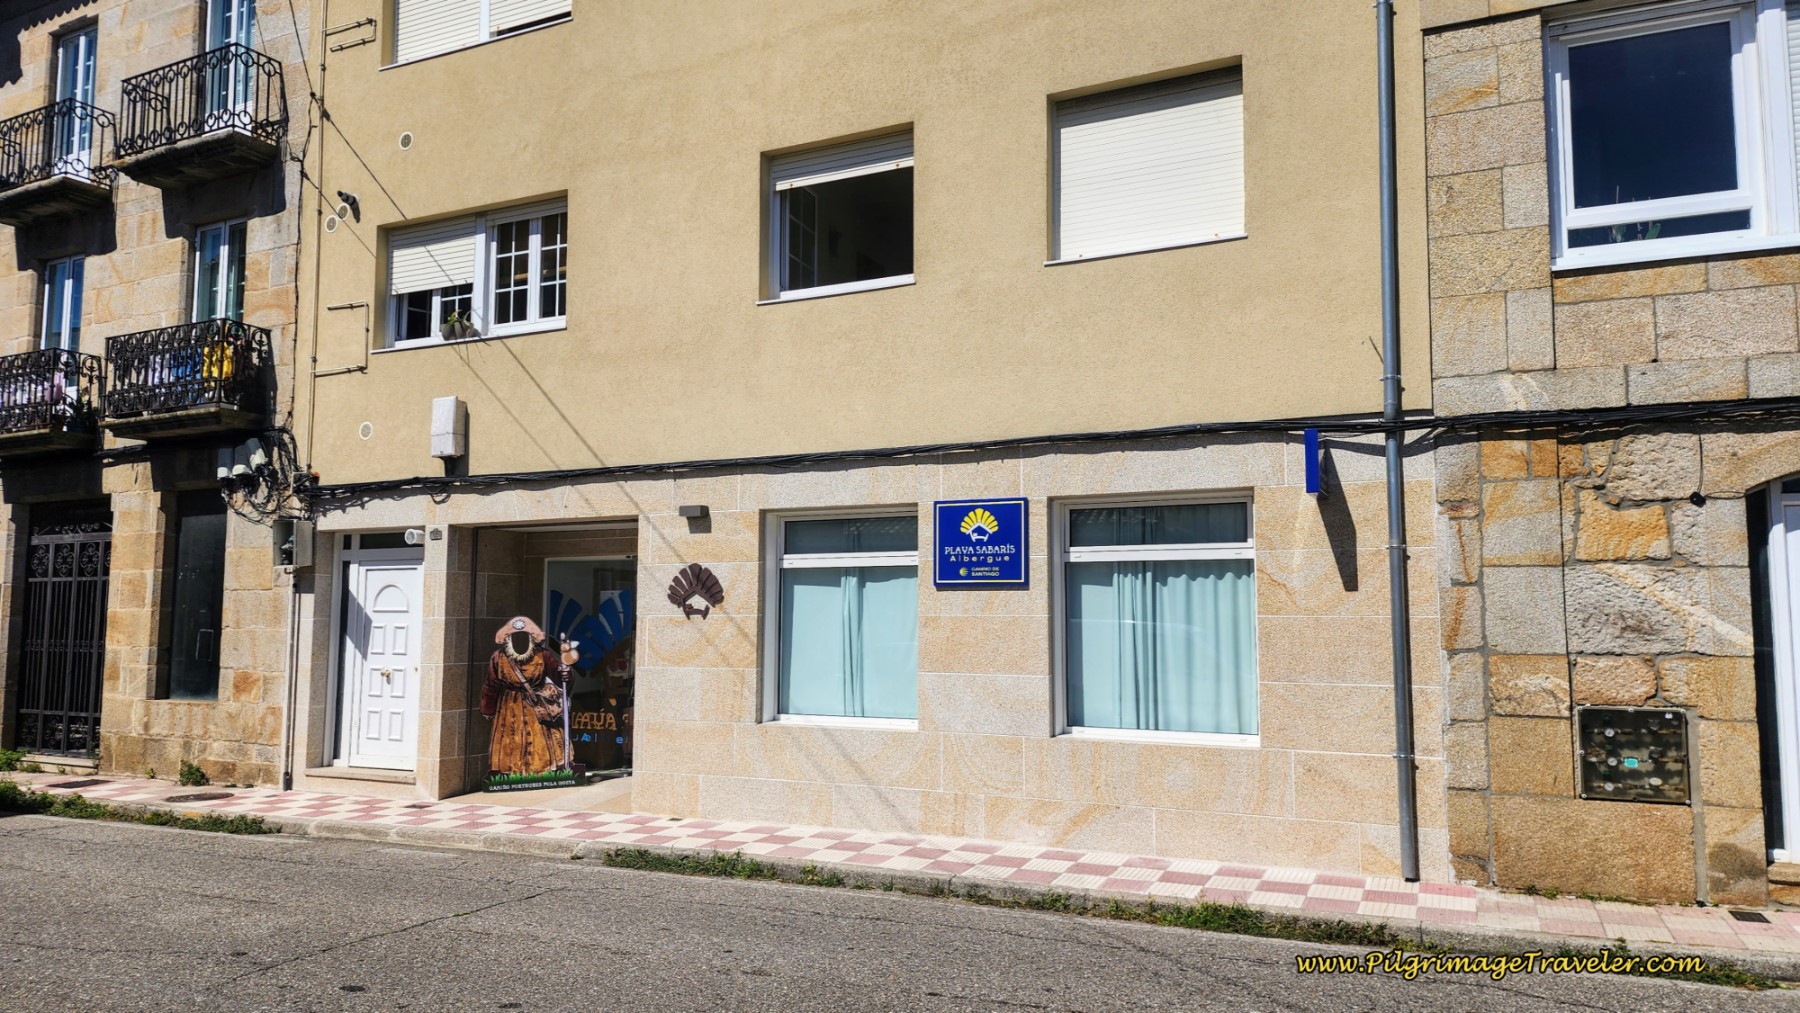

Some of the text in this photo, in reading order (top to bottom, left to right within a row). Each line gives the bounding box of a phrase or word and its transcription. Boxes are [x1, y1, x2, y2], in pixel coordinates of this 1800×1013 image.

[944, 543, 1016, 555] PLAYA SABARÍS
[949, 555, 1010, 563] Albergue
